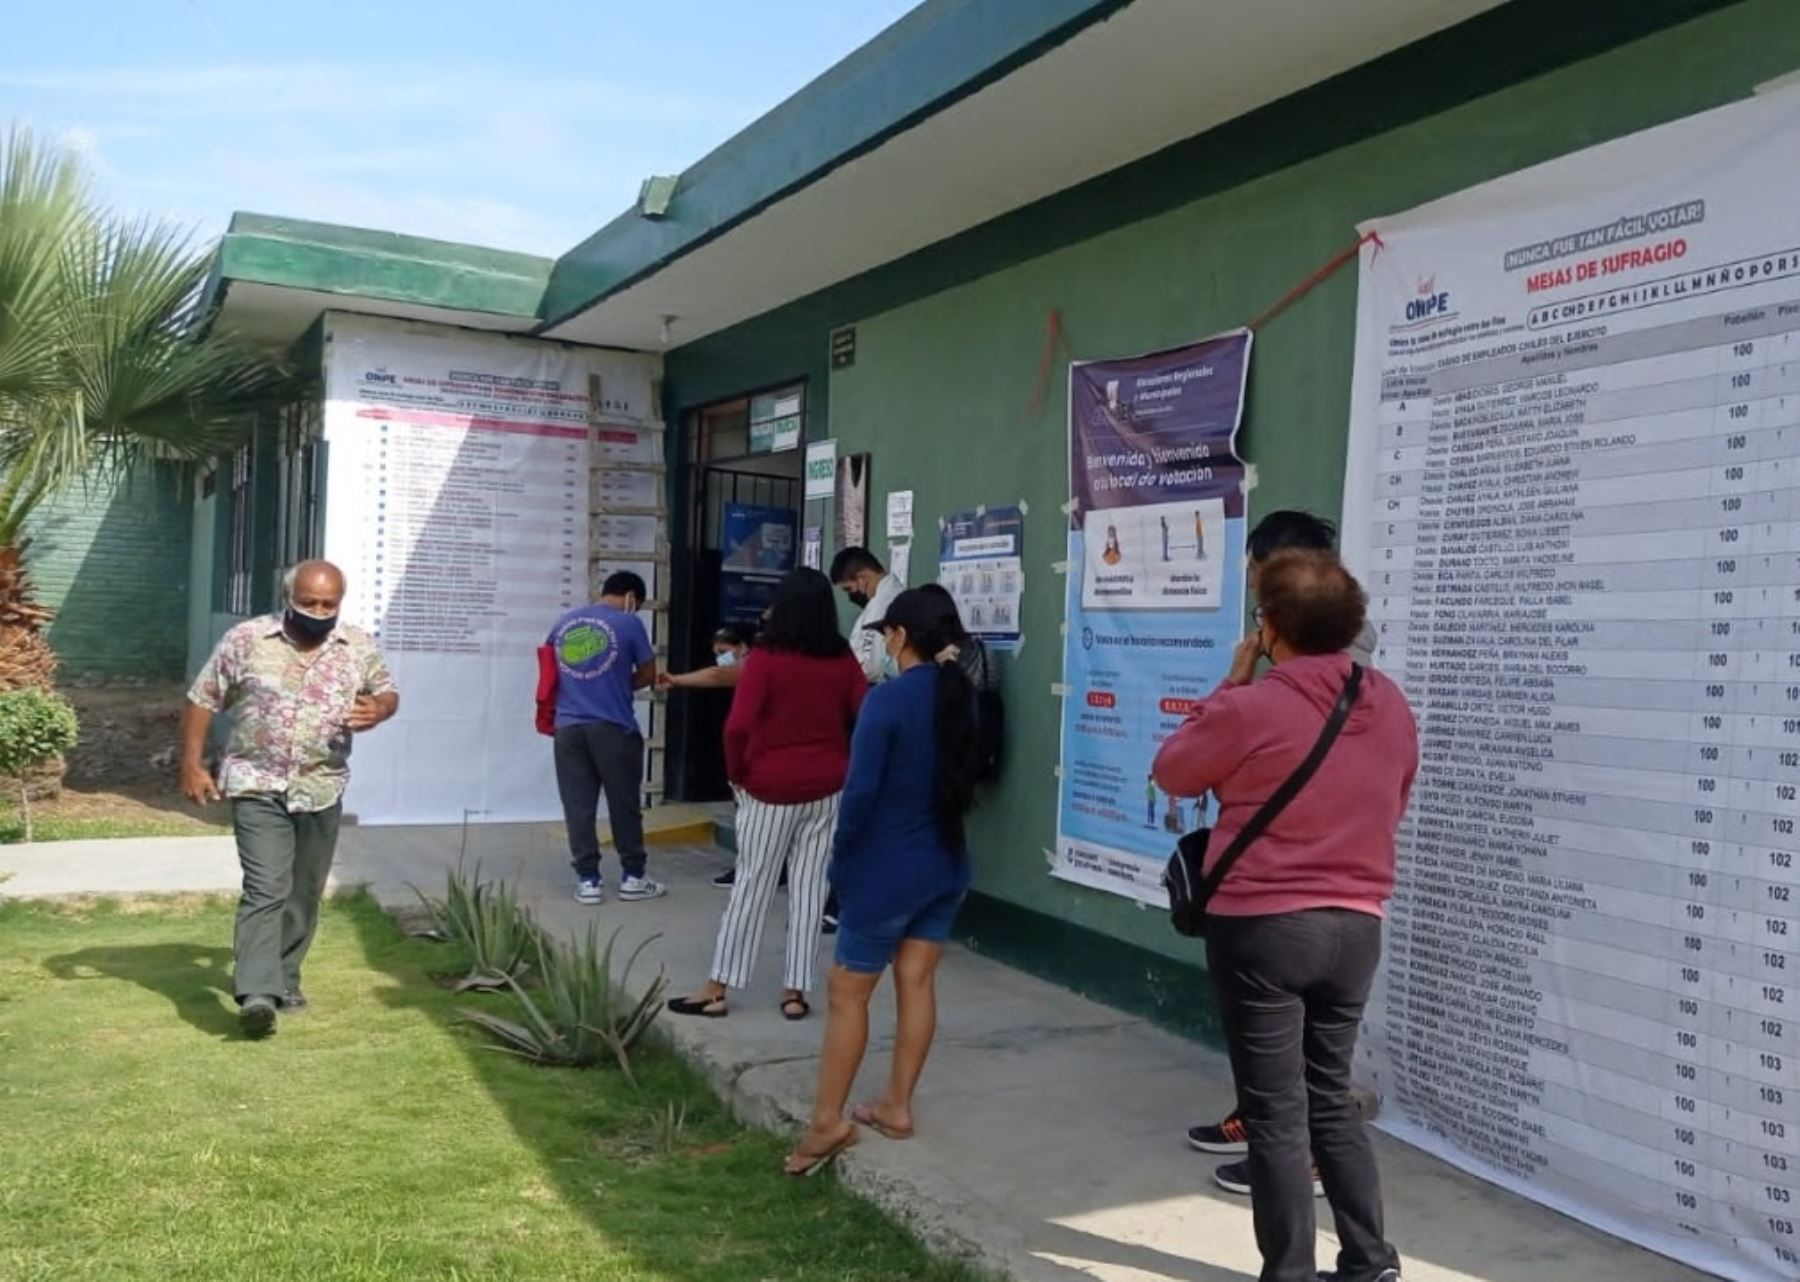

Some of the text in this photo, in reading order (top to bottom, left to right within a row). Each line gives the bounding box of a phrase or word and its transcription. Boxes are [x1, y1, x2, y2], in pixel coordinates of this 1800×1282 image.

[1553, 239, 1576, 256] FUE
[1580, 232, 1604, 249] TAN
[1607, 220, 1644, 241] FÁCIL
[1527, 239, 1687, 294] MESAS DE SUFRAGIO
[1531, 314, 1538, 324] A
[1542, 309, 1548, 320] B
[1552, 308, 1558, 319] C
[1578, 303, 1584, 314] D
[1588, 300, 1594, 311] E
[1600, 299, 1605, 309] F
[1609, 296, 1616, 307] G
[1621, 293, 1628, 304] H
[1651, 287, 1659, 297] K
[1664, 285, 1670, 295] L
[1675, 282, 1687, 293] LL
[1693, 278, 1702, 289] M
[1707, 275, 1715, 286] N
[1721, 269, 1729, 282] Ñ
[1735, 269, 1744, 280] O
[1750, 266, 1758, 277] P
[1778, 258, 1786, 270] R
[1406, 293, 1448, 320] ONPE
[1733, 343, 1753, 356] 100
[1732, 373, 1750, 388] 100
[1399, 401, 1405, 410] A
[1729, 404, 1748, 419] 100
[1727, 435, 1746, 449] 100
[1393, 449, 1400, 460] C
[1725, 467, 1743, 480] 100
[1722, 497, 1741, 511] 100
[1720, 529, 1738, 542] 100
[1717, 560, 1736, 573] 100
[1714, 591, 1733, 604] 100
[1711, 622, 1730, 636] 100
[1709, 654, 1727, 666] 100
[1706, 685, 1724, 697] 100
[1786, 686, 1800, 700] 10
[1703, 716, 1721, 729] 100
[1700, 747, 1718, 761] 100
[1779, 753, 1799, 767] 102
[1698, 779, 1715, 792] 100
[1776, 786, 1795, 800] 102
[1694, 810, 1712, 823] 100
[1773, 819, 1793, 834] 102
[1692, 841, 1710, 856] 100
[1769, 852, 1791, 868] 102
[1689, 872, 1707, 887] 100
[1768, 886, 1789, 901] 102
[1686, 904, 1704, 919] 100
[1766, 919, 1787, 935] 102
[1685, 936, 1702, 951] 100
[1763, 952, 1785, 969] 102
[1682, 968, 1700, 983] 100
[1762, 987, 1784, 1003] 102
[1679, 1000, 1698, 1016] 100
[1760, 1020, 1782, 1037] 102
[1677, 1032, 1696, 1048] 100
[1760, 1054, 1781, 1071] 103
[1676, 1064, 1695, 1080] 100
[1760, 1087, 1782, 1105] 103
[1675, 1096, 1695, 1112] 100
[1675, 1128, 1695, 1145] 100
[1761, 1121, 1784, 1138] 103
[1674, 1160, 1695, 1177] 100
[1763, 1153, 1787, 1171] 103
[1676, 1192, 1696, 1209] 100
[1765, 1187, 1790, 1203] 103
[1768, 1218, 1793, 1234] 103
